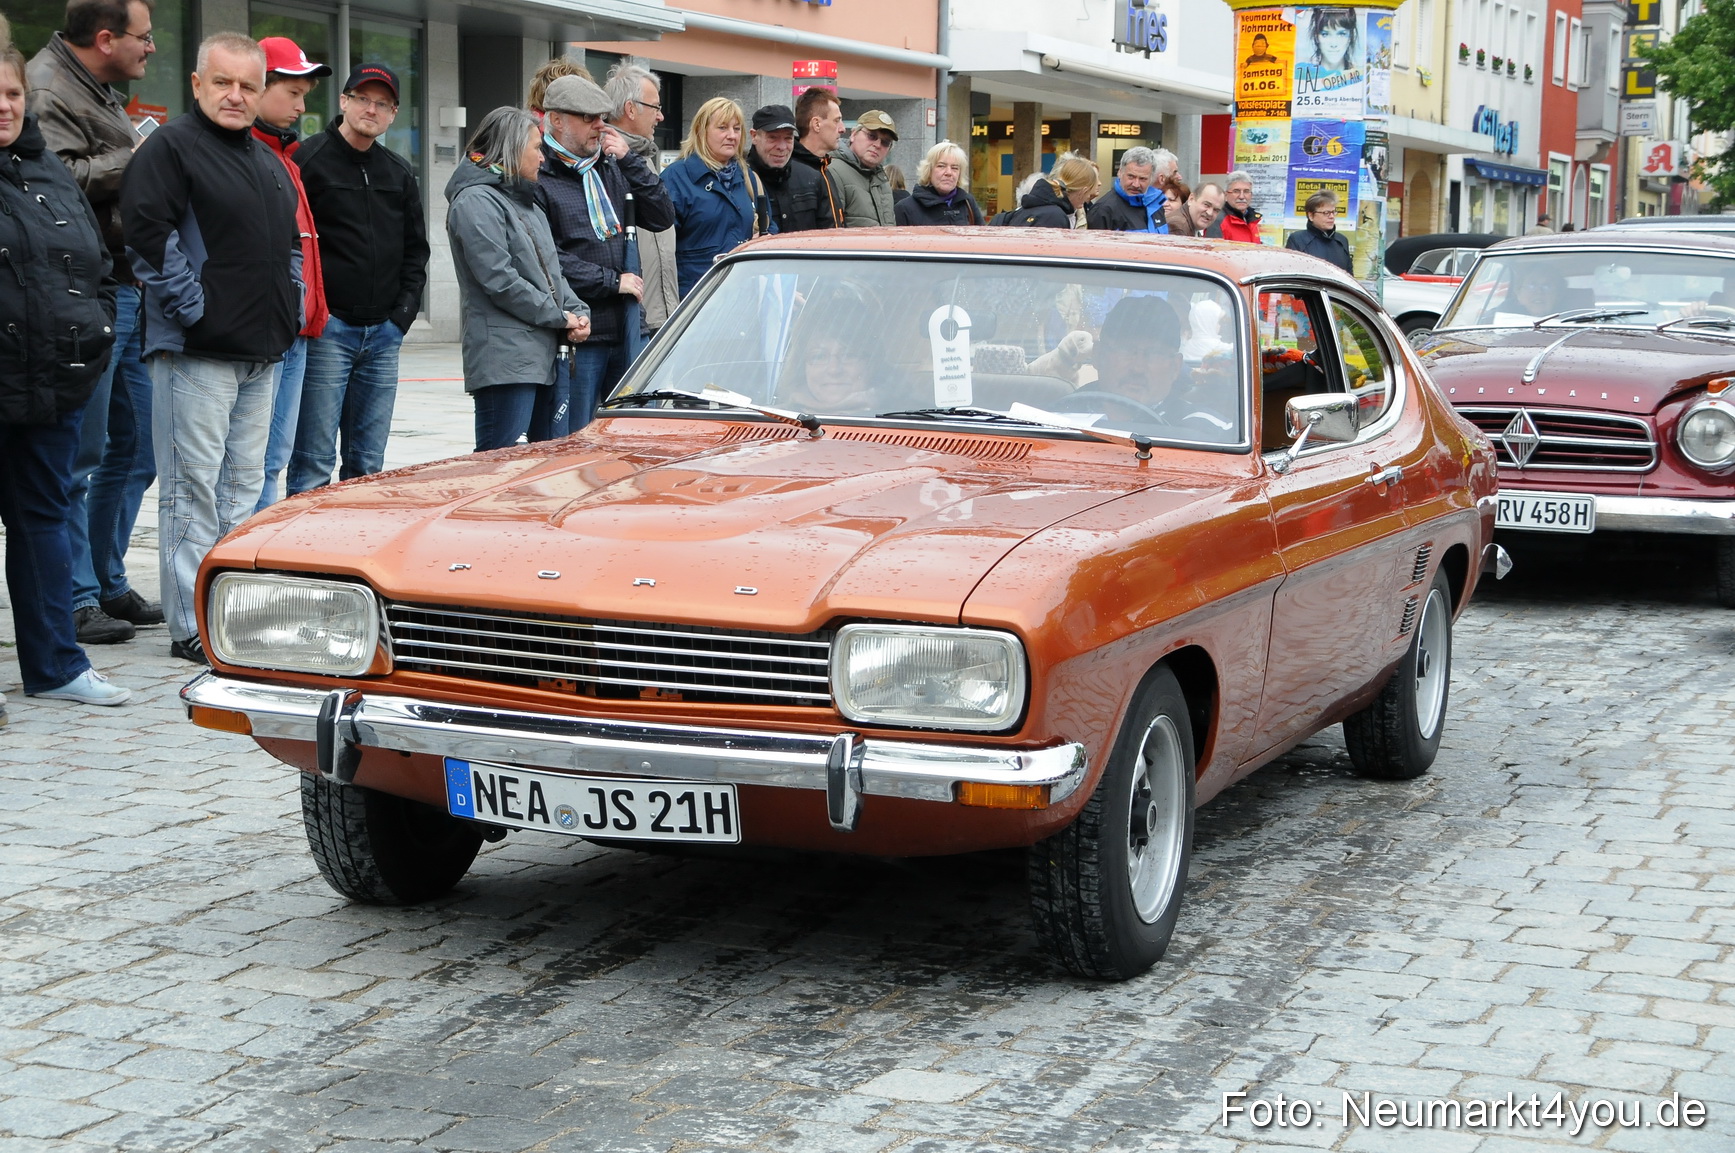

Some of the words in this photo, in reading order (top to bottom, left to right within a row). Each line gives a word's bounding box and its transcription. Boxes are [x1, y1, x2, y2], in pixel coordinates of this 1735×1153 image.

[1241, 13, 1282, 22] Neumarkt
[1241, 23, 1292, 33] Flohmarkt
[362, 68, 392, 81] HONDA
[808, 62, 819, 76] T
[1243, 69, 1282, 79] Samstag
[1297, 65, 1321, 94] ZAZ
[1324, 74, 1347, 91] OPEN
[1349, 70, 1362, 85] AIR
[1243, 80, 1280, 91] 01.06.
[1238, 101, 1287, 110] Volksfestplatz
[1296, 96, 1324, 106] 25.6.
[1626, 112, 1649, 120] Stern
[1100, 124, 1141, 136] FRIES
[1325, 184, 1346, 192] Night
[1497, 499, 1526, 524] RV
[1530, 501, 1588, 526] 458H
[448, 563, 759, 596] FORD
[457, 793, 467, 806] D
[473, 770, 551, 824] NEA
[583, 787, 638, 831] JS
[648, 791, 732, 835] 21H
